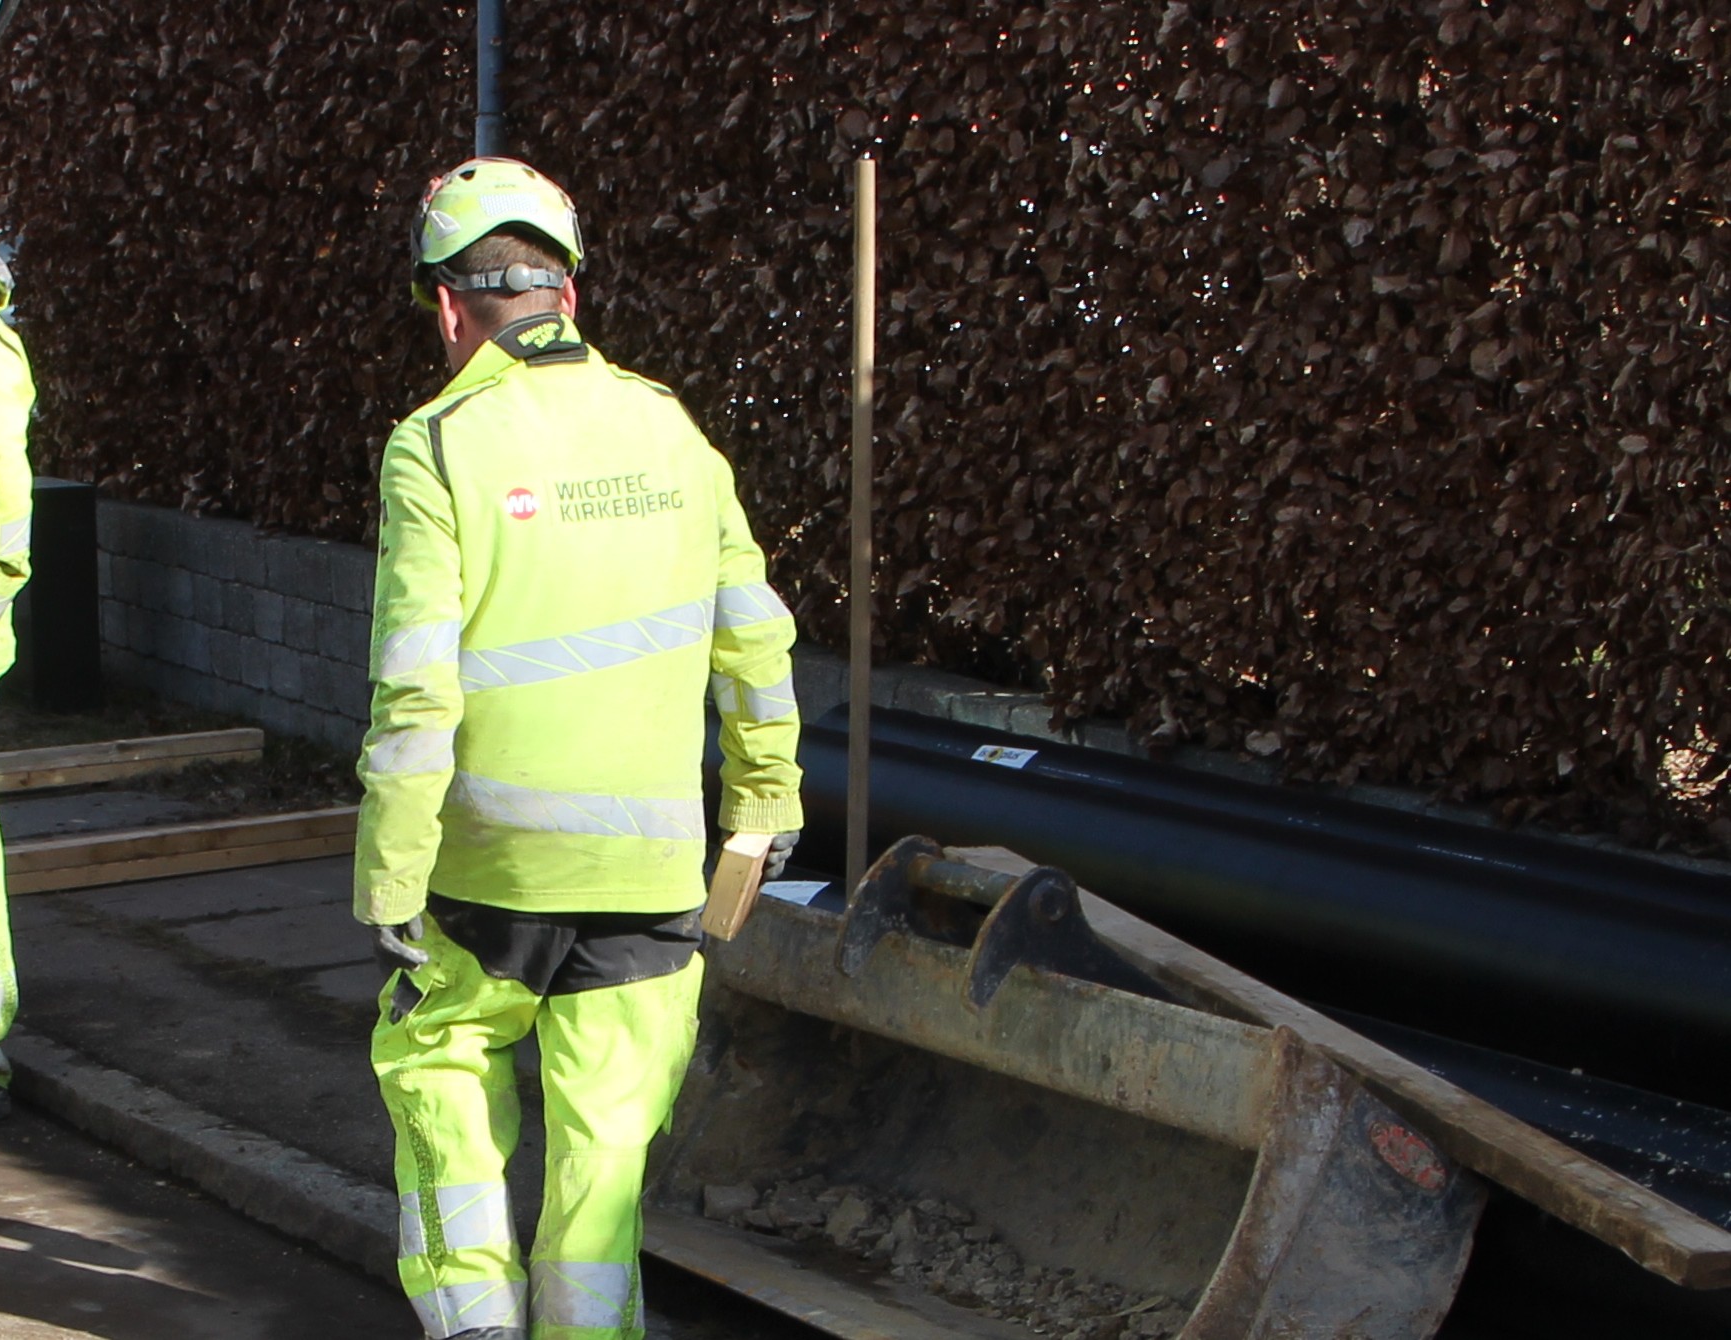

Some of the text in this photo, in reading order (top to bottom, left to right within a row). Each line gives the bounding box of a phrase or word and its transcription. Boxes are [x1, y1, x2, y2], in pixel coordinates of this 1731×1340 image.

[555, 473, 649, 501] WICOTEC
[504, 493, 540, 515] WK
[560, 490, 684, 523] KIRKEBJERG
